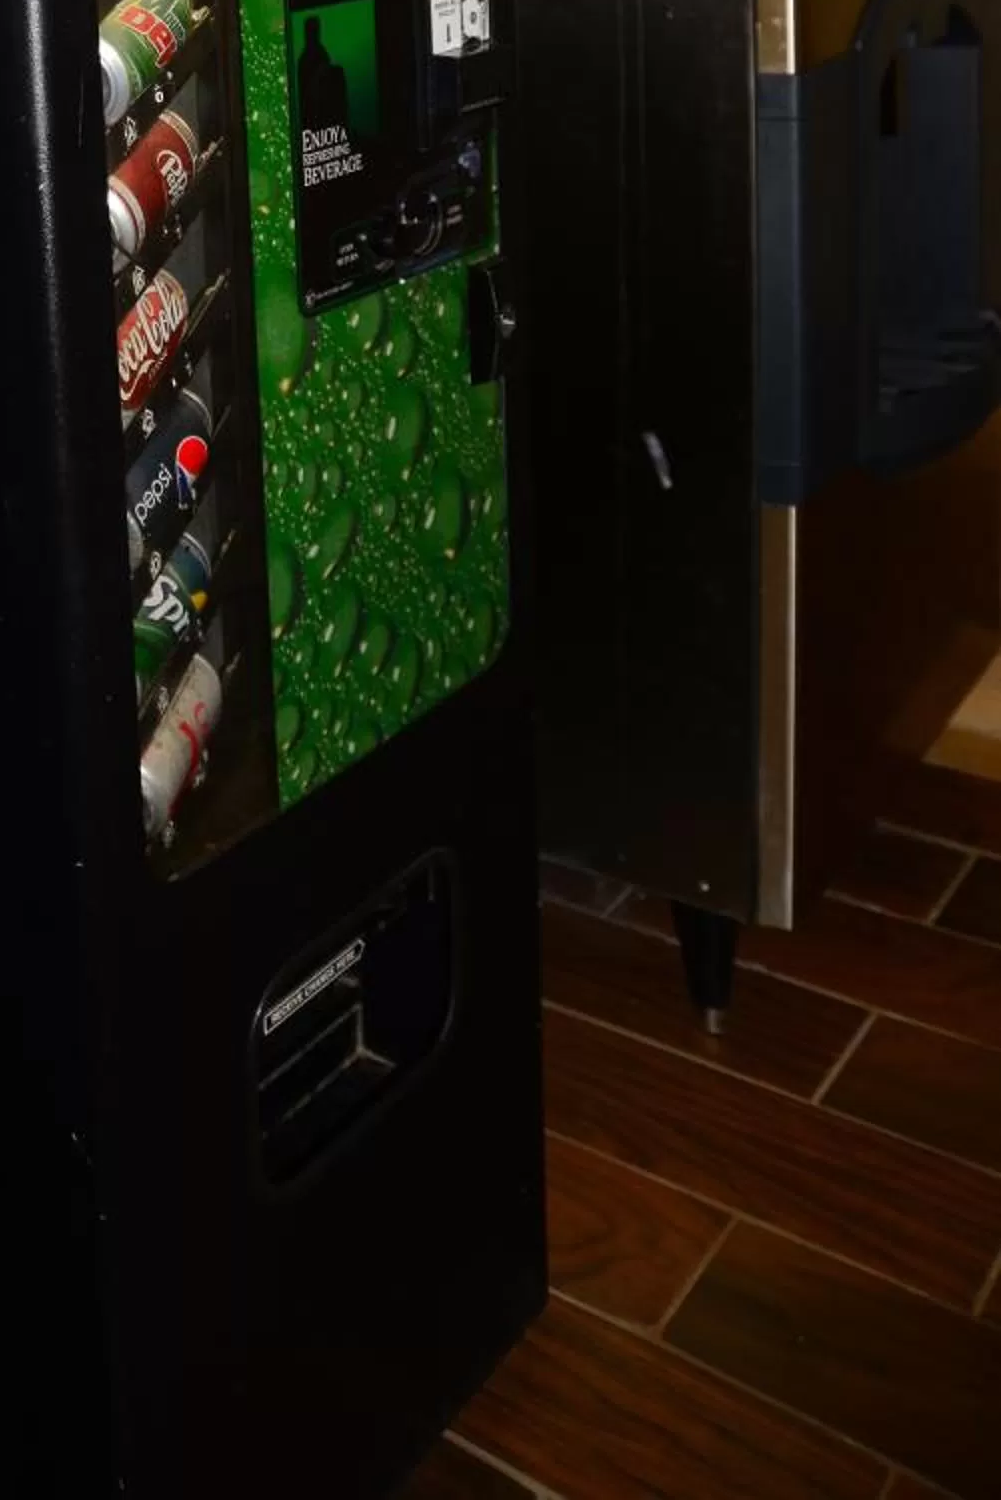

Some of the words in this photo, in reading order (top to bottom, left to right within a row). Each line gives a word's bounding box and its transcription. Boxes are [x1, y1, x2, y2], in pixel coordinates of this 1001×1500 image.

[302, 125, 340, 152] ENJOY
[303, 153, 364, 187] BEVERAGE
[135, 462, 173, 527] pepsi
